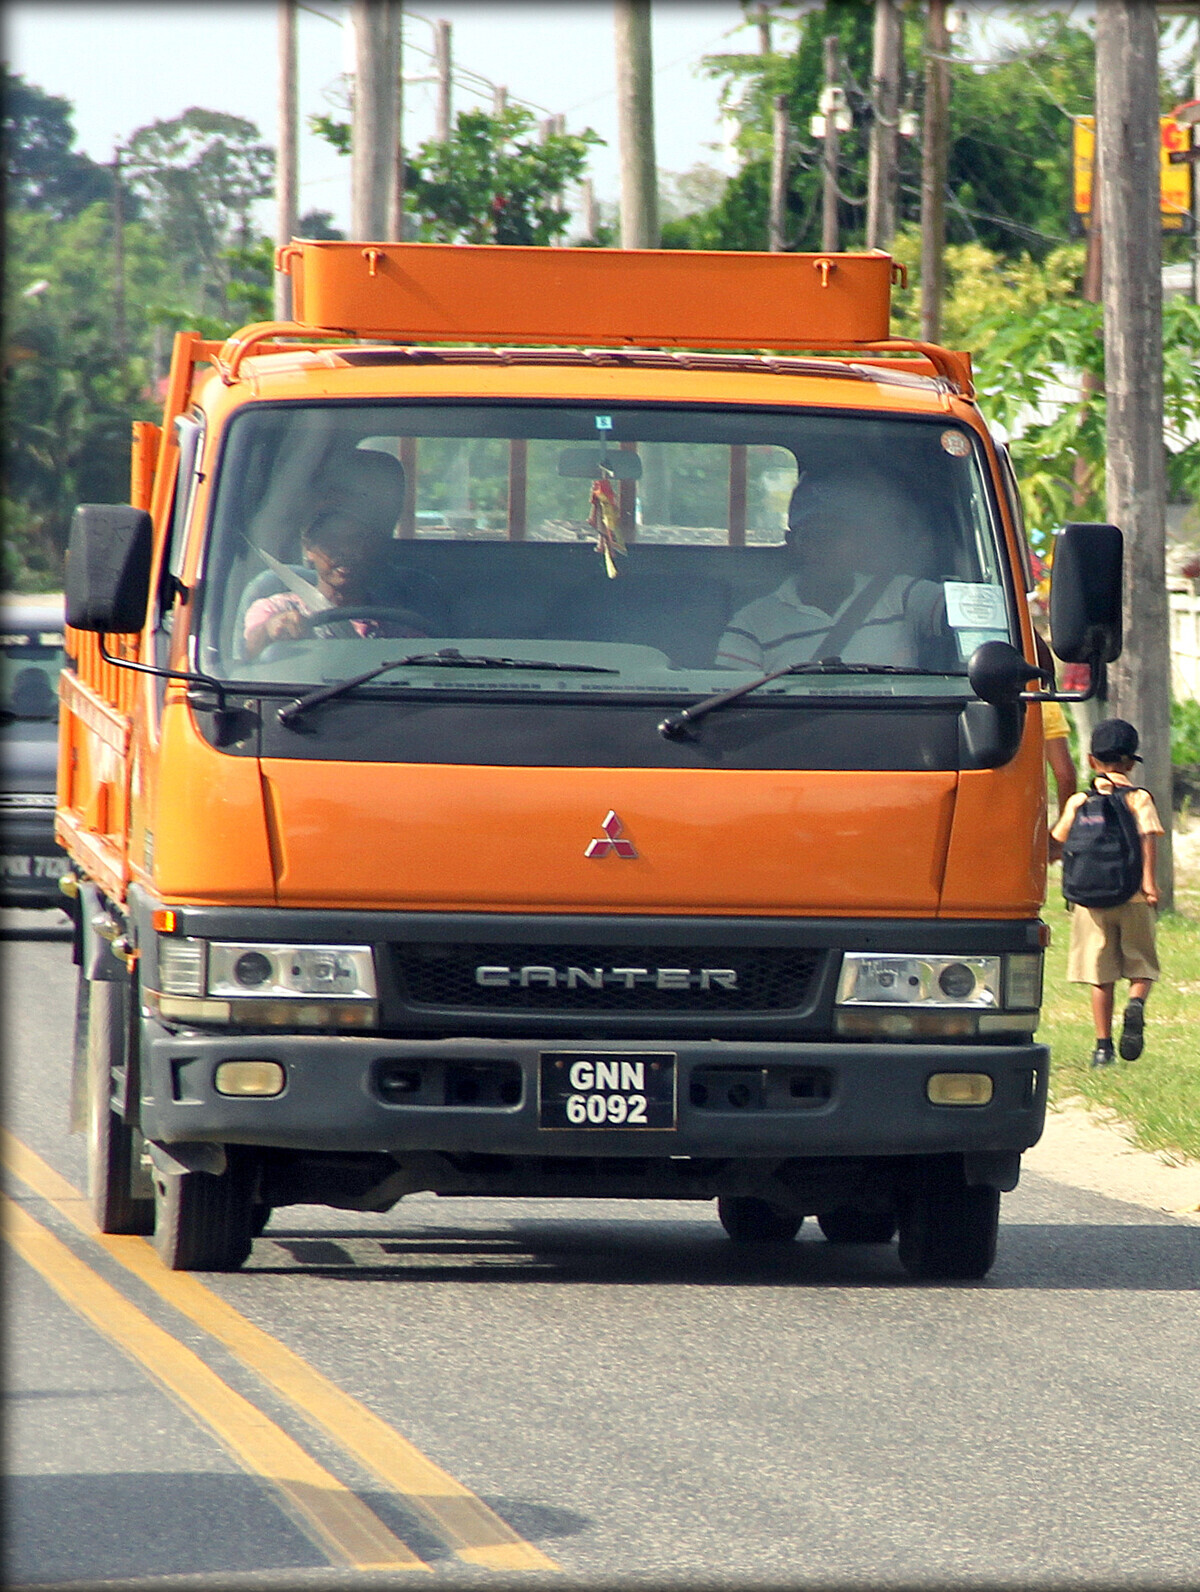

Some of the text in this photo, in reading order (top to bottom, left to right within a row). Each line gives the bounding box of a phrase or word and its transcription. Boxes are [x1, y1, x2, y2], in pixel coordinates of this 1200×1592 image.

[475, 965, 740, 990] CANTER
[569, 1061, 645, 1090] GNN
[566, 1094, 648, 1124] 6092
